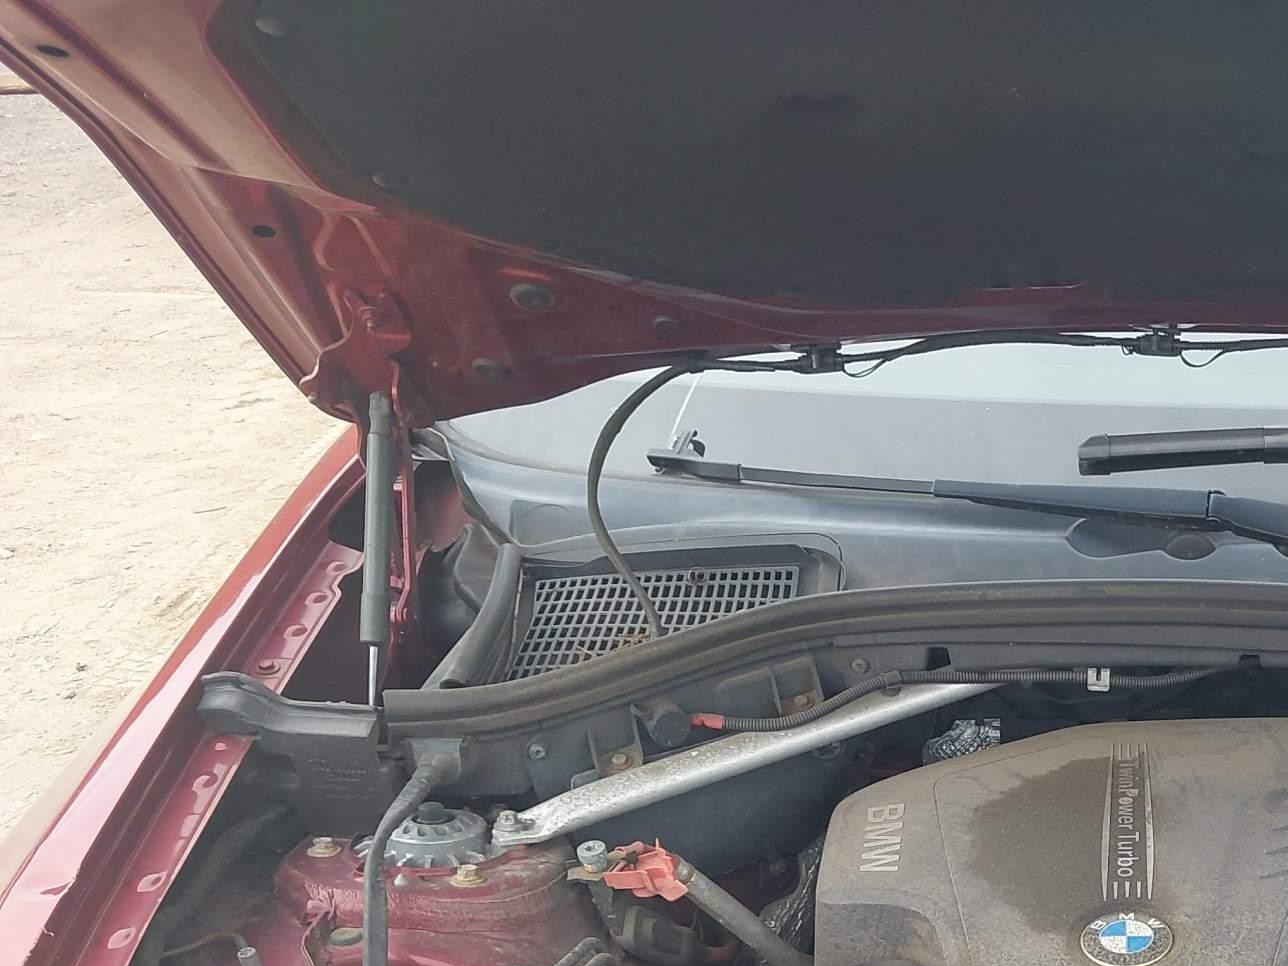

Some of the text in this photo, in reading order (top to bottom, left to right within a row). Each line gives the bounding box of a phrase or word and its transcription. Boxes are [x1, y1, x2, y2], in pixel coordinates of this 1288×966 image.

[859, 802, 905, 873] BMW
[1116, 760, 1140, 878] TwinPower Turbo
